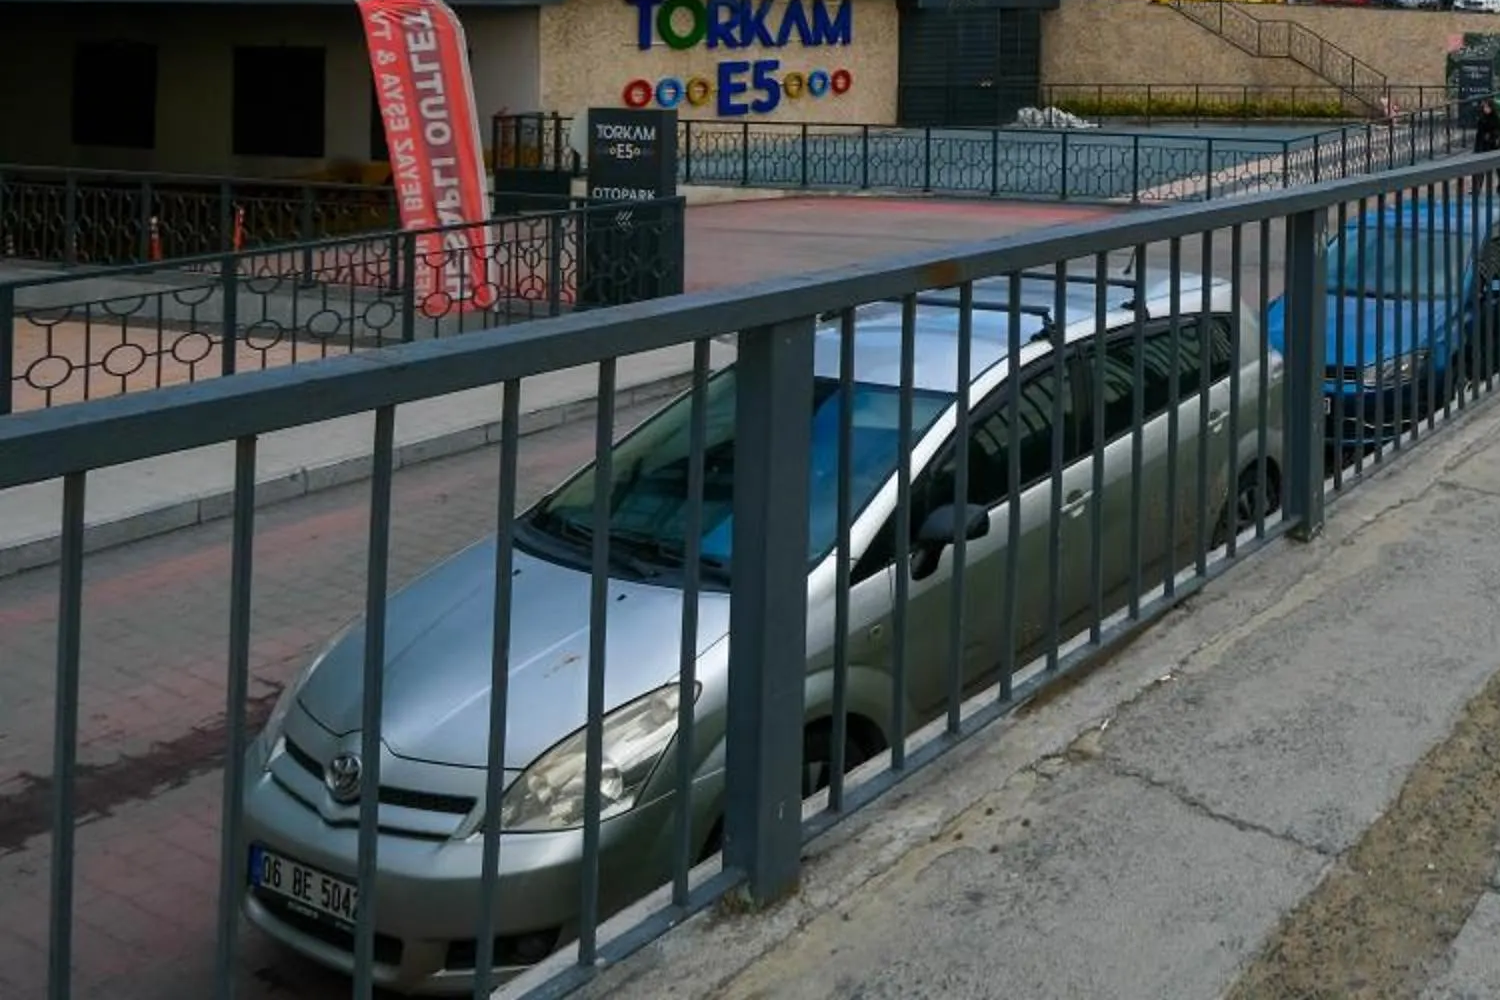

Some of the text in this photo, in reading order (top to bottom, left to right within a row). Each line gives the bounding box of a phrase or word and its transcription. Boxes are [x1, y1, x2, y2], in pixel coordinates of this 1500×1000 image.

[716, 59, 781, 117] E5
[596, 125, 657, 141] TORKAM
[592, 187, 656, 201] OTOPARK
[263, 855, 282, 888] 06
[293, 866, 313, 900] BE
